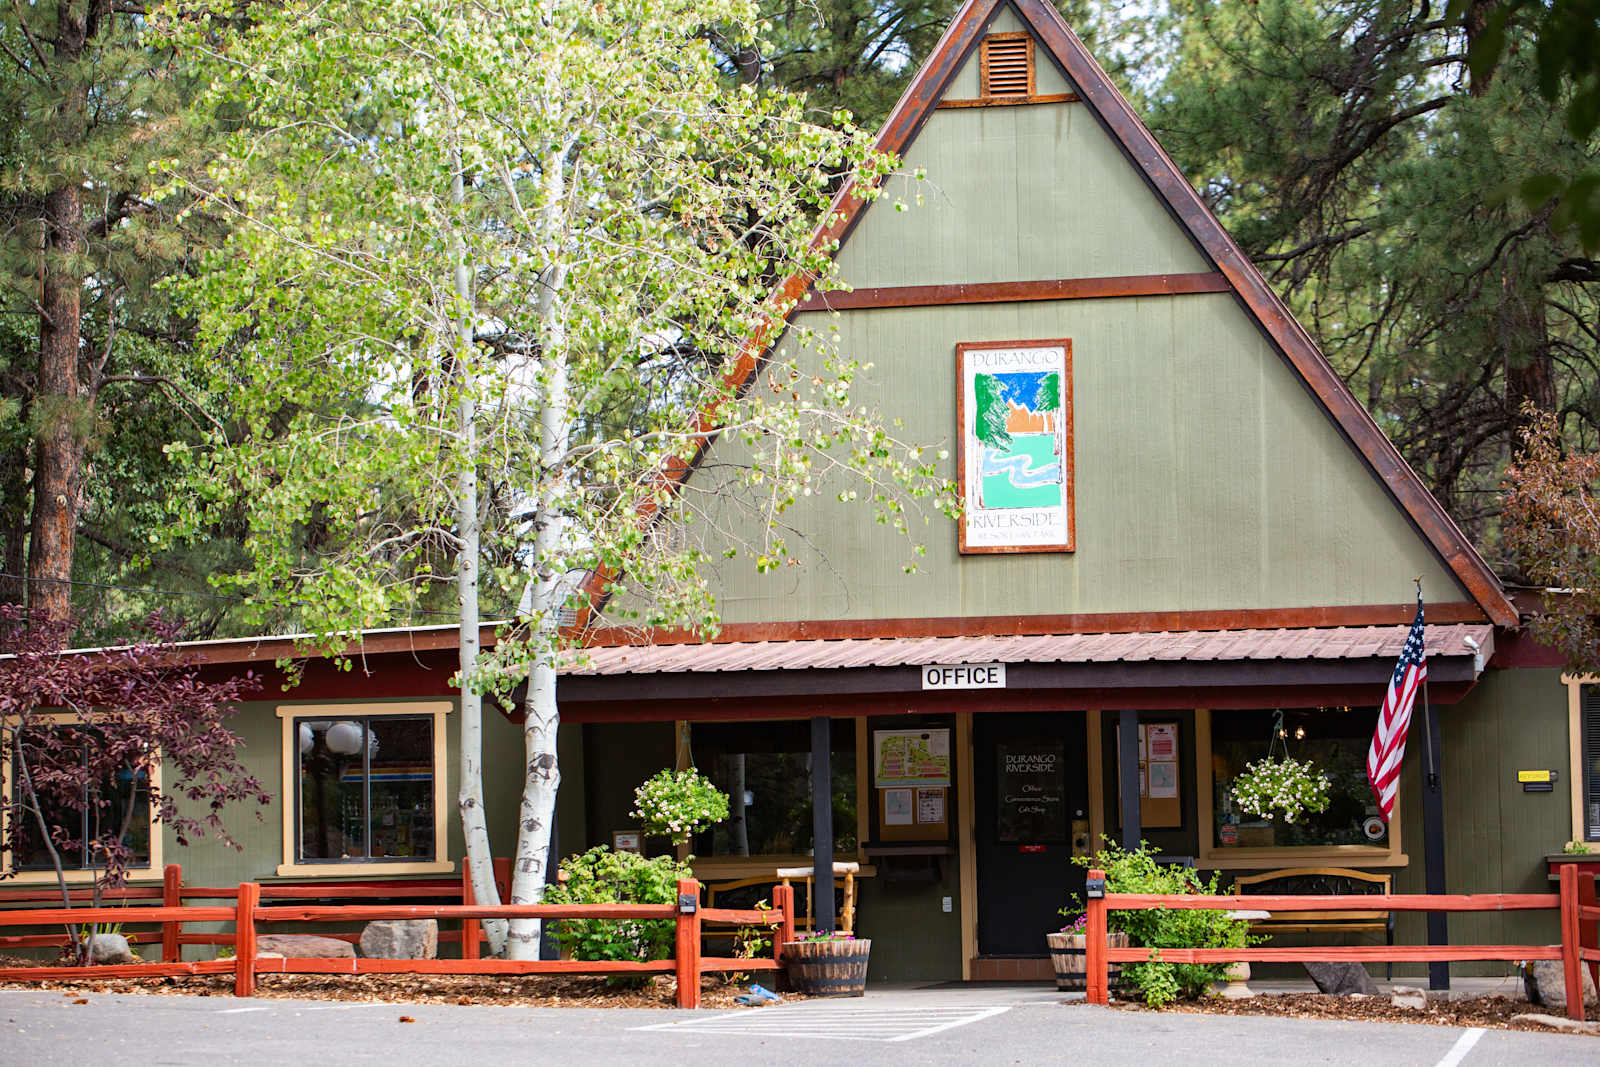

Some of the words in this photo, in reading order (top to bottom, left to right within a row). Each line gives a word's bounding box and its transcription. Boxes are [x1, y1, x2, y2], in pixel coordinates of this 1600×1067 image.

[972, 350, 1058, 368] DURANGO
[973, 511, 1060, 529] RIVERSIDE
[927, 667, 998, 685] OFFICE
[1006, 754, 1056, 764] DURANGO
[1006, 763, 1056, 773] RIVERSIDE
